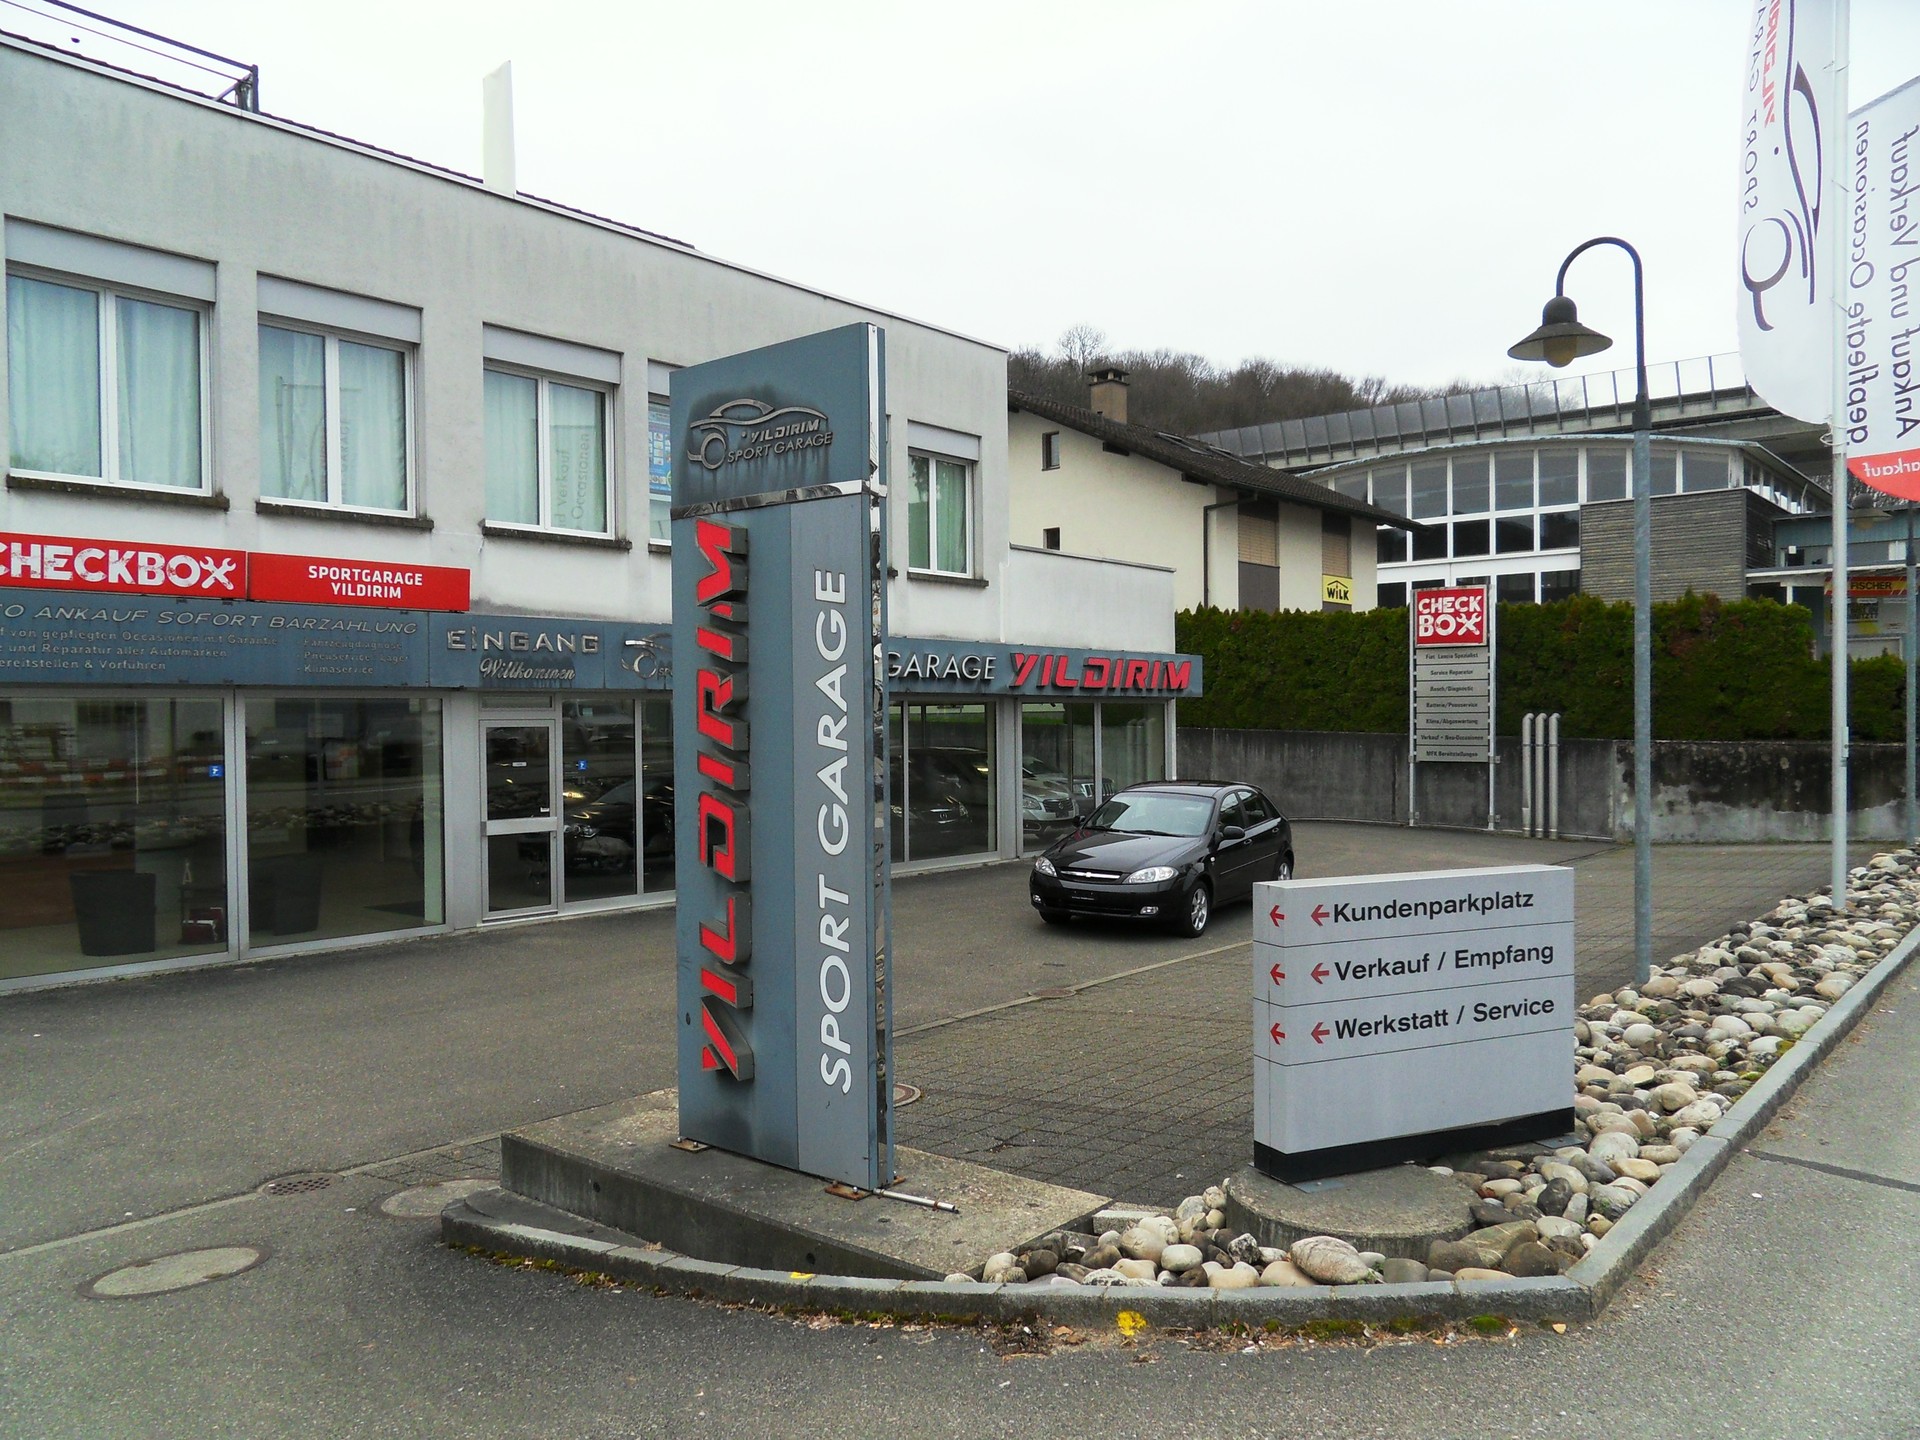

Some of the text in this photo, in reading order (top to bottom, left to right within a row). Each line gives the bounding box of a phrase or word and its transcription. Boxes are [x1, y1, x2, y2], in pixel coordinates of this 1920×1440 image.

[751, 419, 820, 443] YILDIRIM
[727, 432, 832, 463] SPORT GARAGE
[0, 541, 236, 590] HECKBOX
[308, 565, 423, 586] SPORTGARAGE
[331, 582, 401, 599] YILDIRIM
[1851, 581, 1892, 590] FISCHER
[1418, 595, 1482, 614] CHECK
[11, 629, 36, 637] von
[34, 606, 148, 622] ANKAUF
[158, 611, 262, 627] SOFORT
[269, 616, 417, 635] BARZAHLUNG
[1419, 612, 1482, 637] BOX
[9, 643, 36, 652] und
[42, 643, 112, 655] Reparatur
[84, 660, 93, 669] &
[480, 658, 576, 681] Willkommen
[1010, 652, 1192, 689] YILDIRIM
[697, 518, 748, 1082] YILDIRIM
[814, 569, 852, 1095] SPORT GARAGE
[1333, 891, 1534, 923] Kundenparkplatz
[1334, 944, 1554, 981] Verkauf / Empfang
[1335, 998, 1554, 1039] Werkstatt / Service
